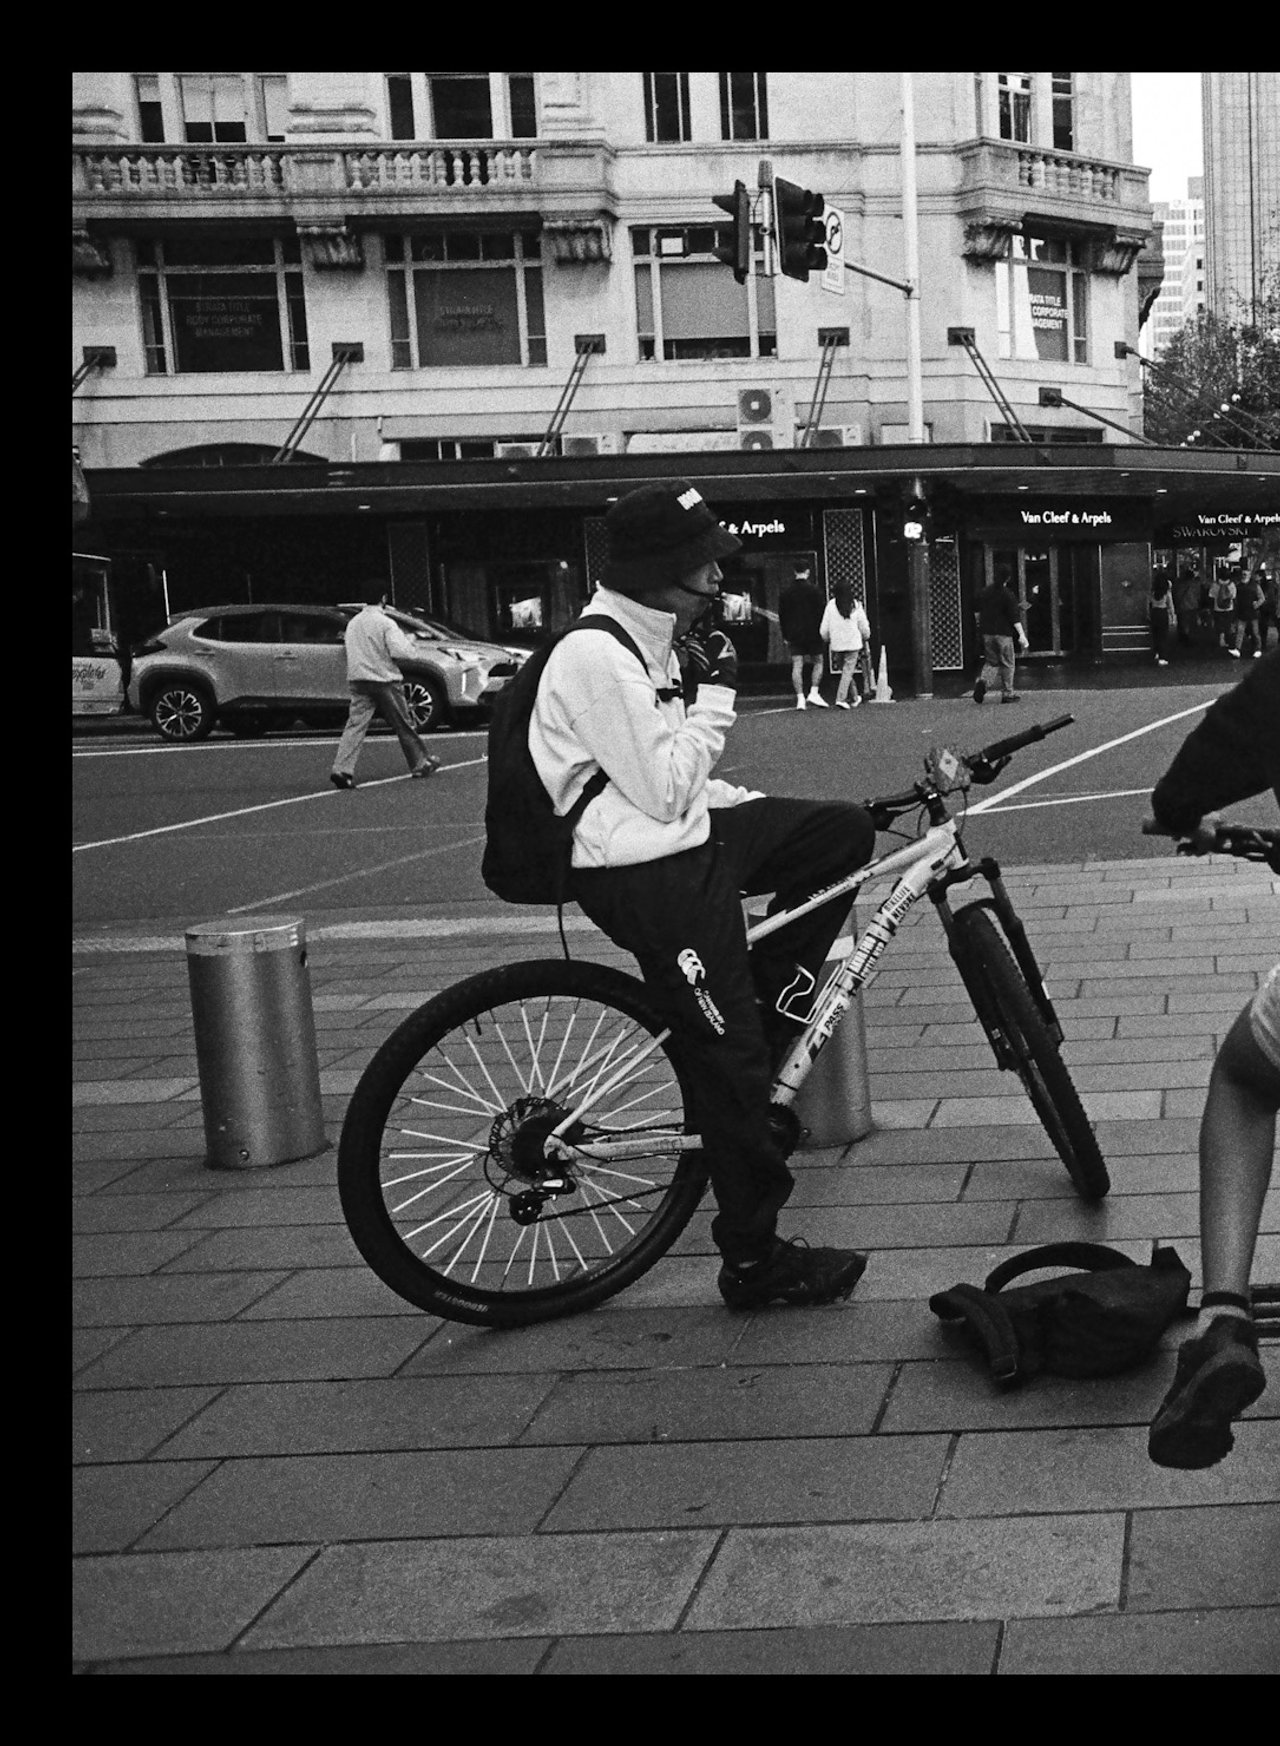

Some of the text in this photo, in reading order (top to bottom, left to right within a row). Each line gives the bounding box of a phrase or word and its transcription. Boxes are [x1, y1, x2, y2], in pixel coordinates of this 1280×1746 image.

[1021, 511, 1112, 527] Van Cleef & Arpels
[1198, 514, 1216, 524] Van
[1218, 514, 1243, 524] Cleef
[1244, 515, 1251, 524] &
[728, 523, 739, 534] &
[741, 519, 785, 538] Arpels
[824, 1002, 843, 1031] PASS
